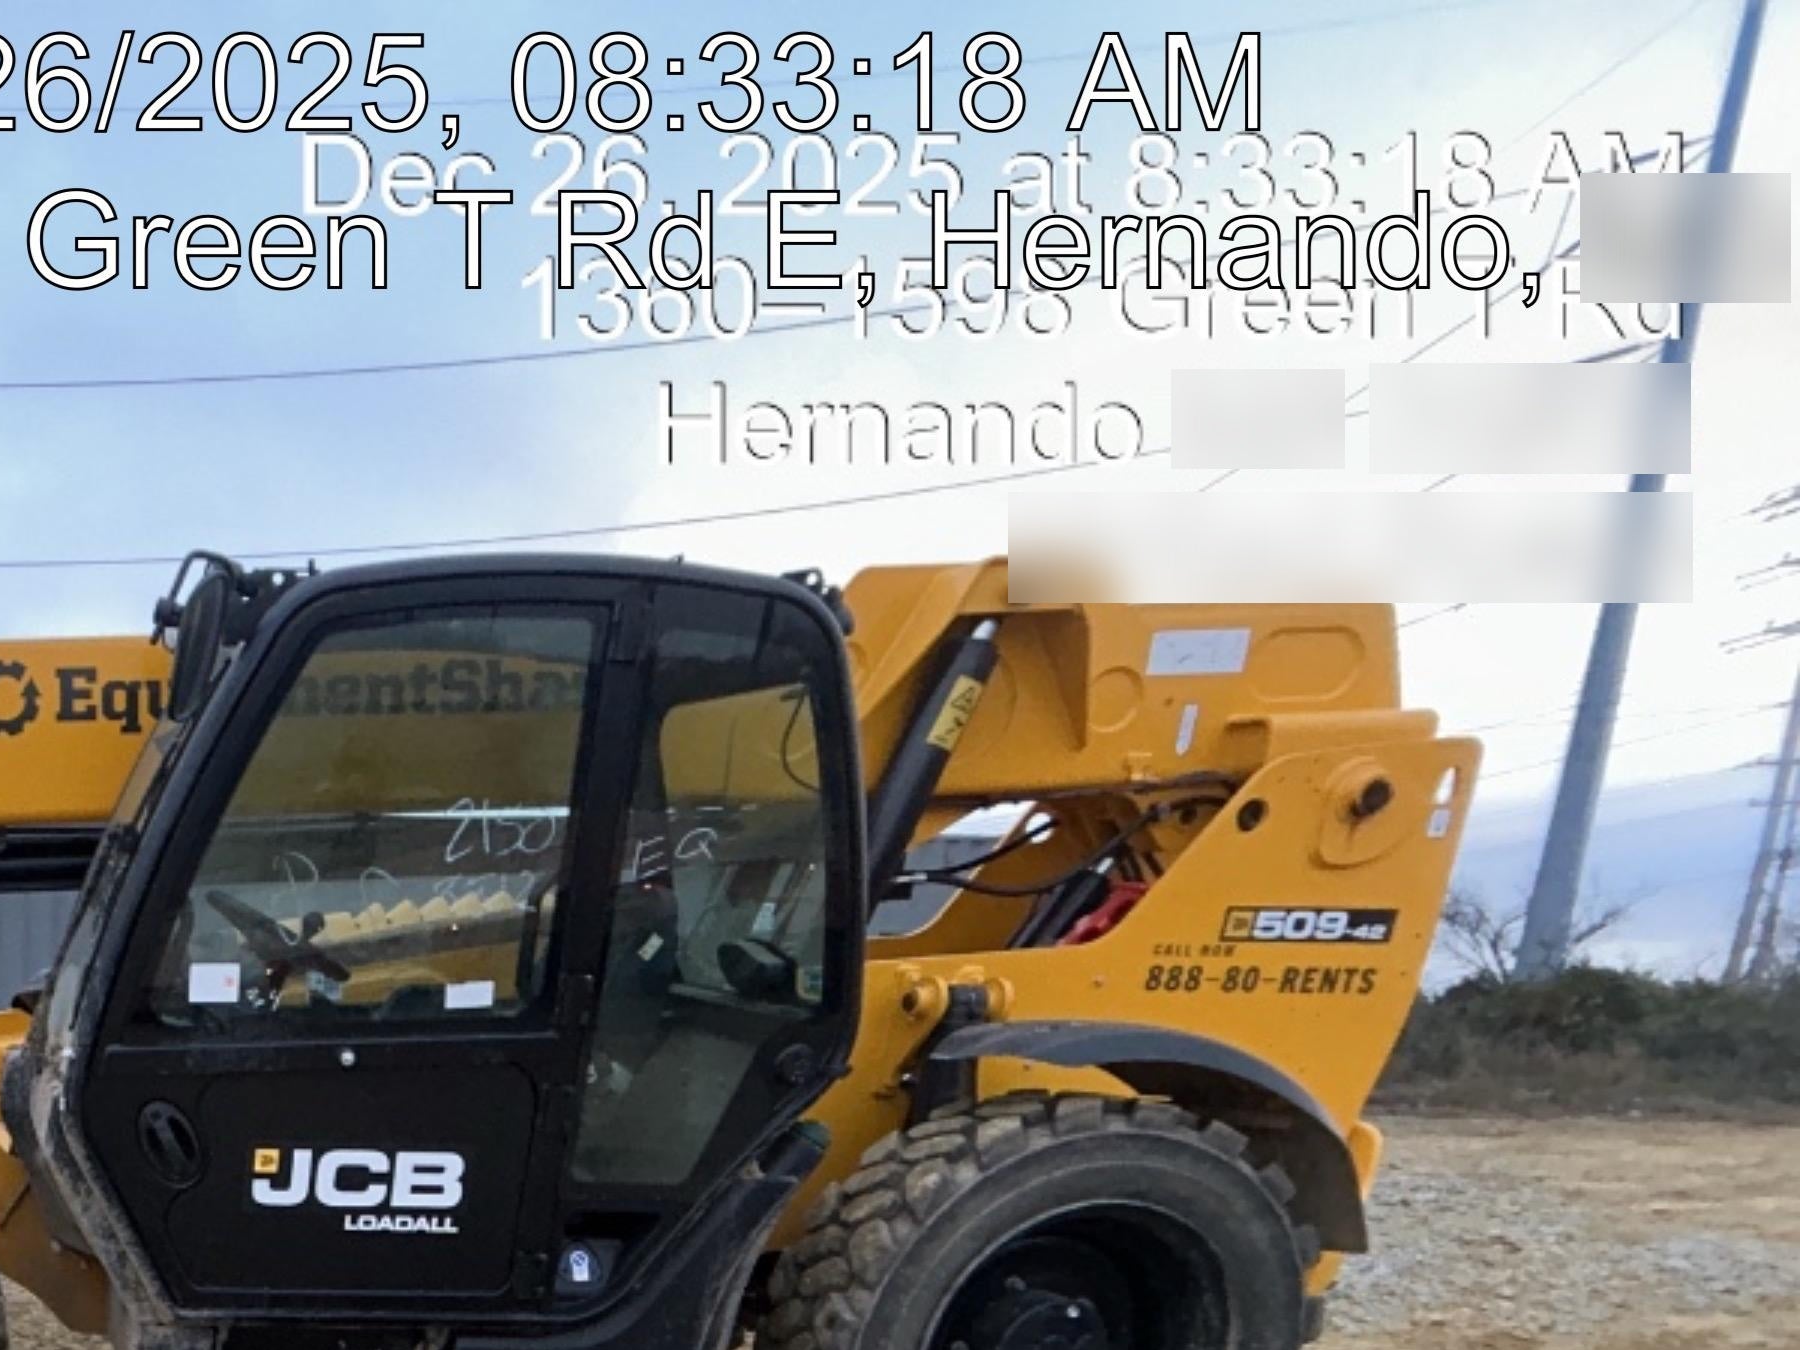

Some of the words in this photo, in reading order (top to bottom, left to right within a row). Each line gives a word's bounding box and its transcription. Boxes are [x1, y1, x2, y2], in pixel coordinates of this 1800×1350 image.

[1253, 910, 1388, 940] 509-42
[1152, 943, 1193, 958] CALL
[1201, 943, 1237, 959] NOW
[1144, 964, 1378, 995] 888-80-RENTS
[251, 1148, 466, 1209] JCB
[343, 1213, 460, 1235] LOADALL
